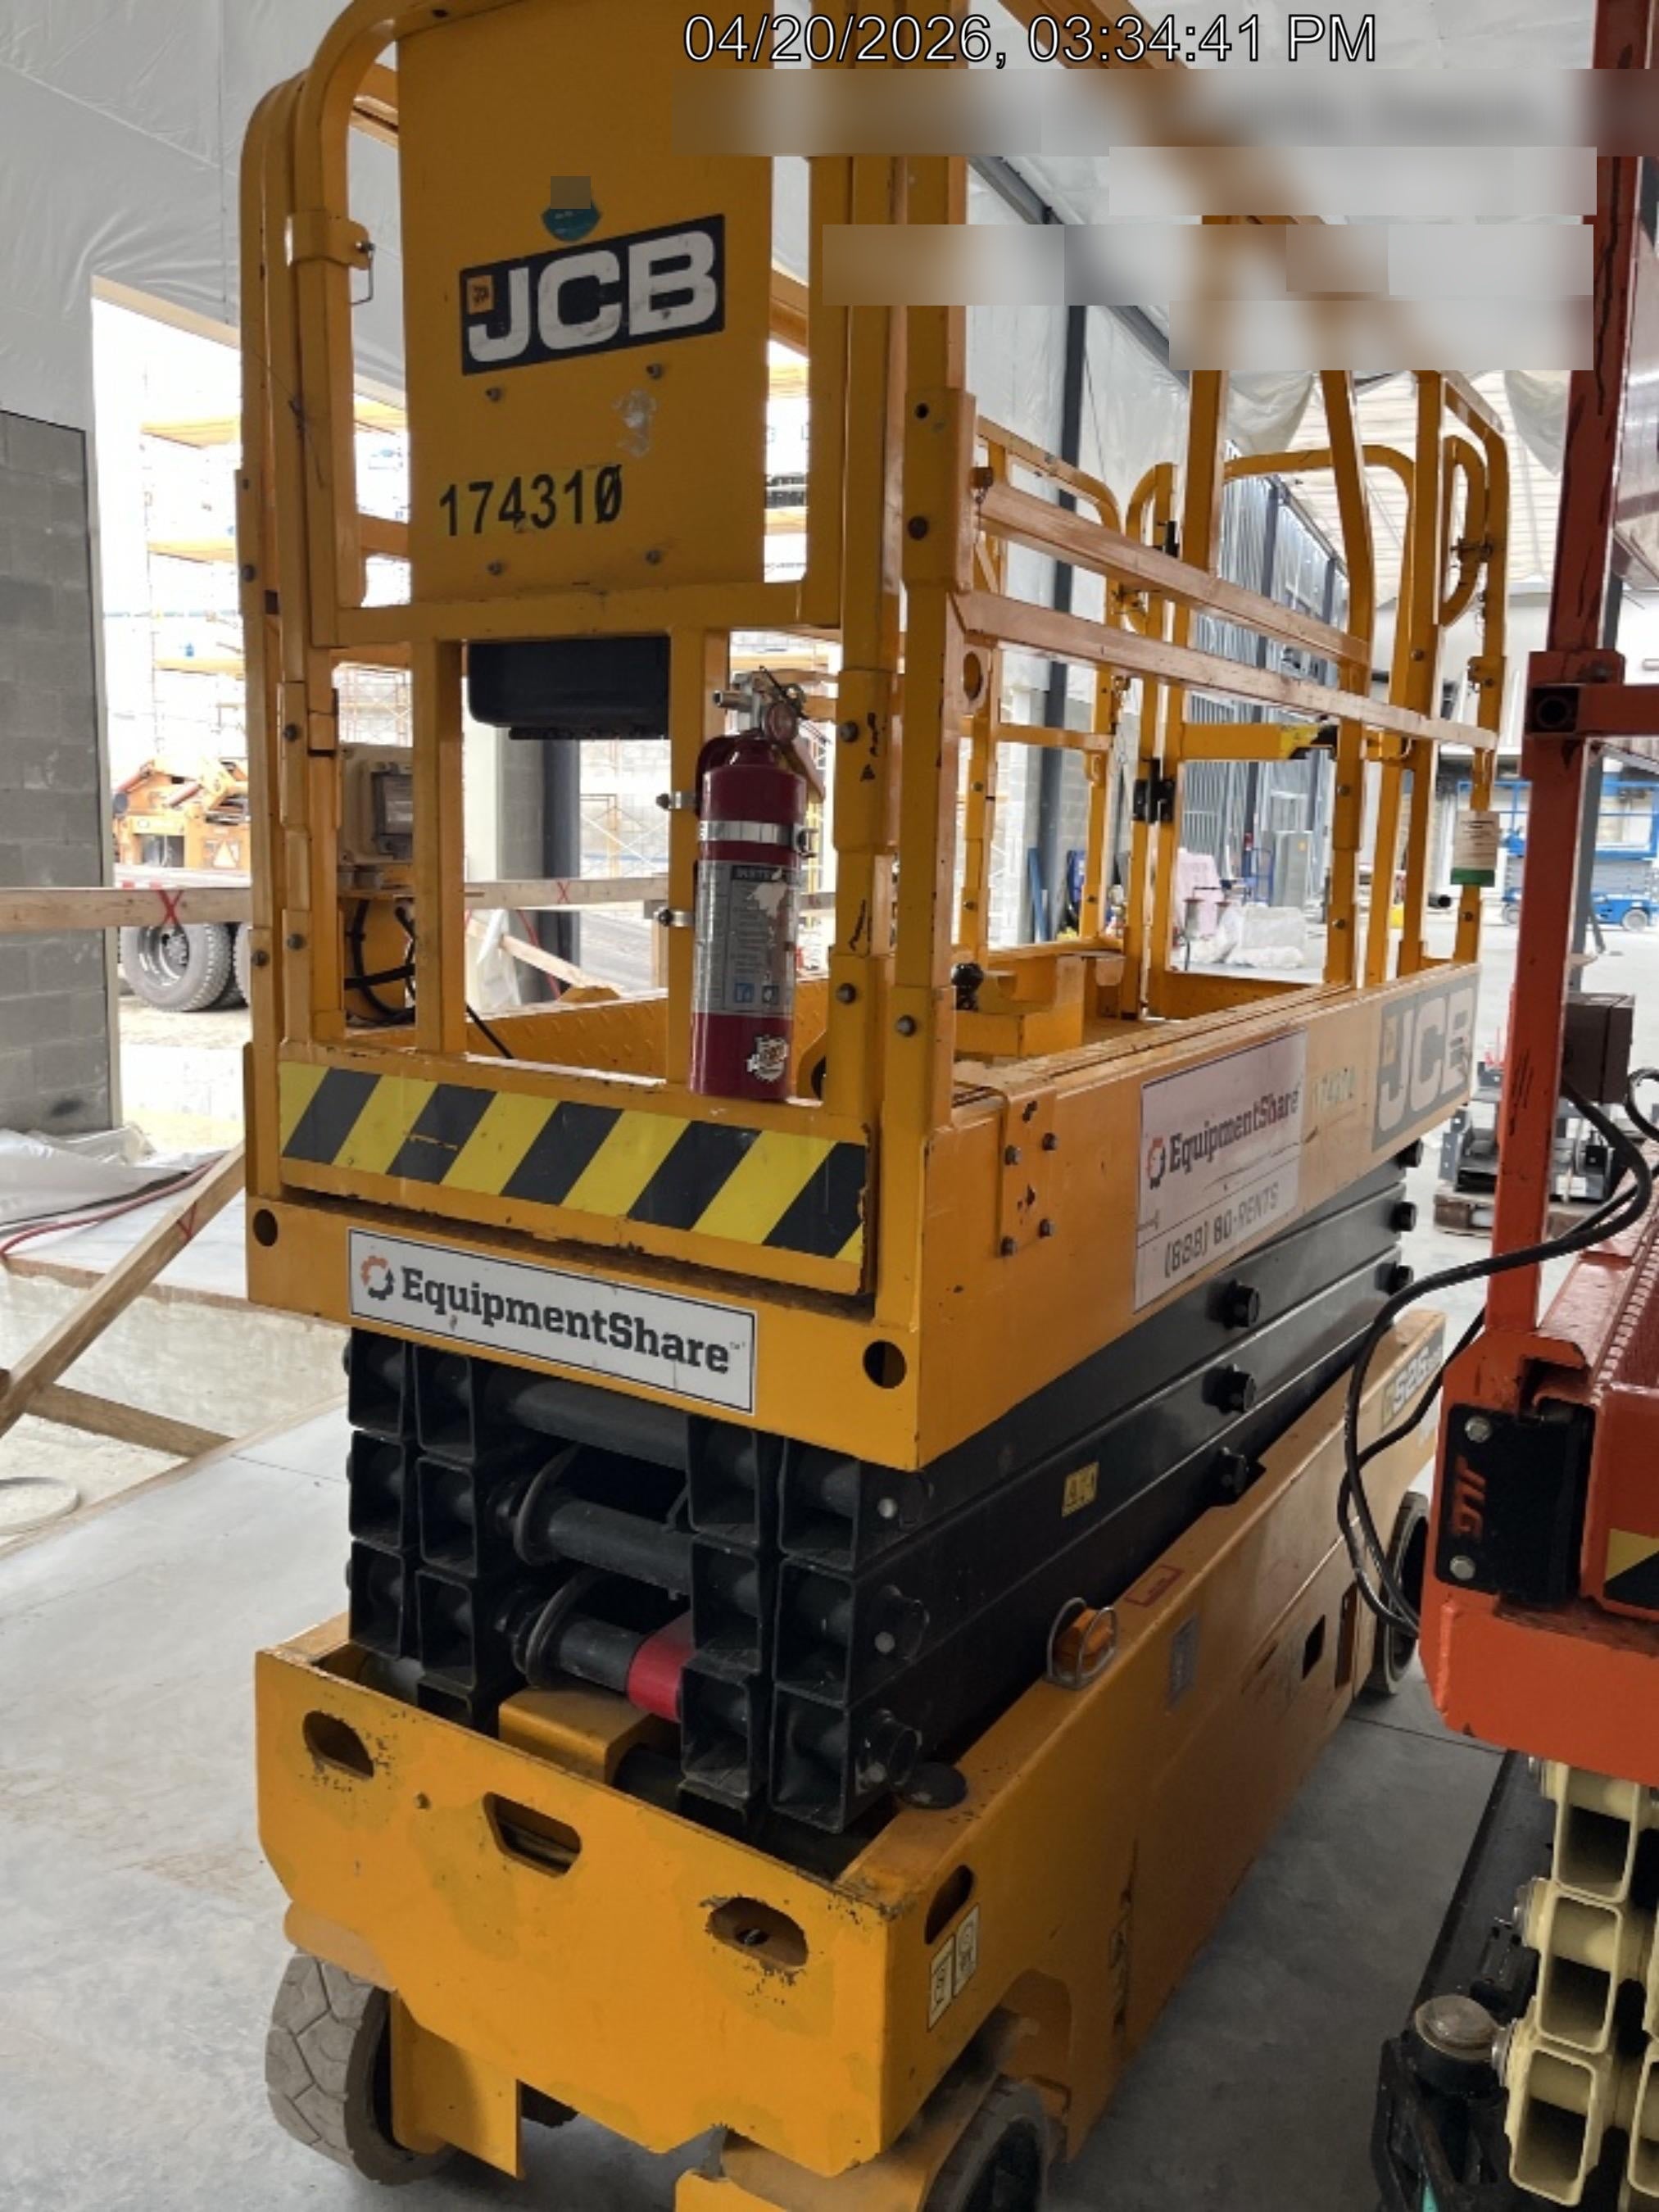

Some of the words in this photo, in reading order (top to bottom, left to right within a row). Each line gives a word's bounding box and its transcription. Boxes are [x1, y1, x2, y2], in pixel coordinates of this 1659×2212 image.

[468, 230, 718, 362] JCB
[439, 464, 623, 537] 174310
[1379, 988, 1474, 1132] JCB
[1169, 1091, 1300, 1175] EquipmentShare
[401, 1266, 730, 1375] EquipmentShare
